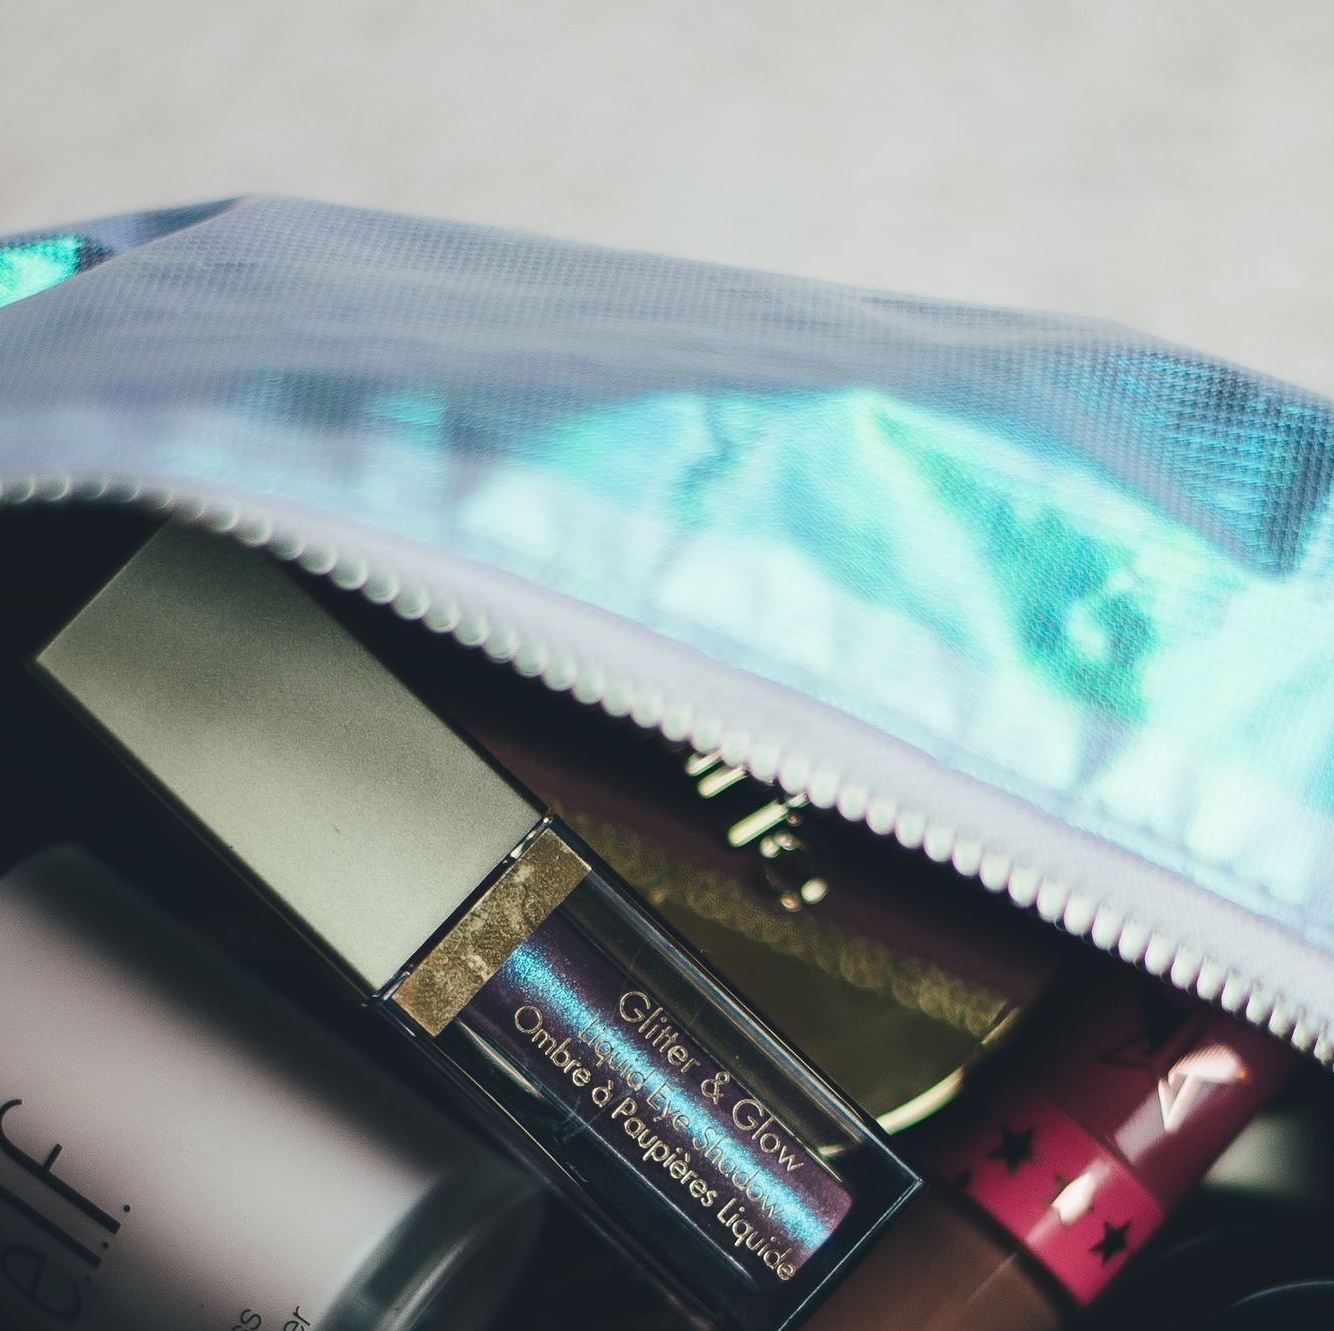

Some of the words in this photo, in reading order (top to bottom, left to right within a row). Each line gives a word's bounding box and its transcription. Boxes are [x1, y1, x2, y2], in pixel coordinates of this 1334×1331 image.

[514, 1005, 591, 1087] Ombre
[591, 1079, 615, 1108] à
[611, 1096, 717, 1208] Paupières
[717, 1198, 796, 1281] Liquide
[578, 1018, 656, 1092] Liquid
[646, 1081, 691, 1131] Eye
[692, 1126, 784, 1218] Shadow
[619, 990, 701, 1074] Glitter
[700, 1071, 731, 1105] &
[732, 1098, 805, 1172] Glow
